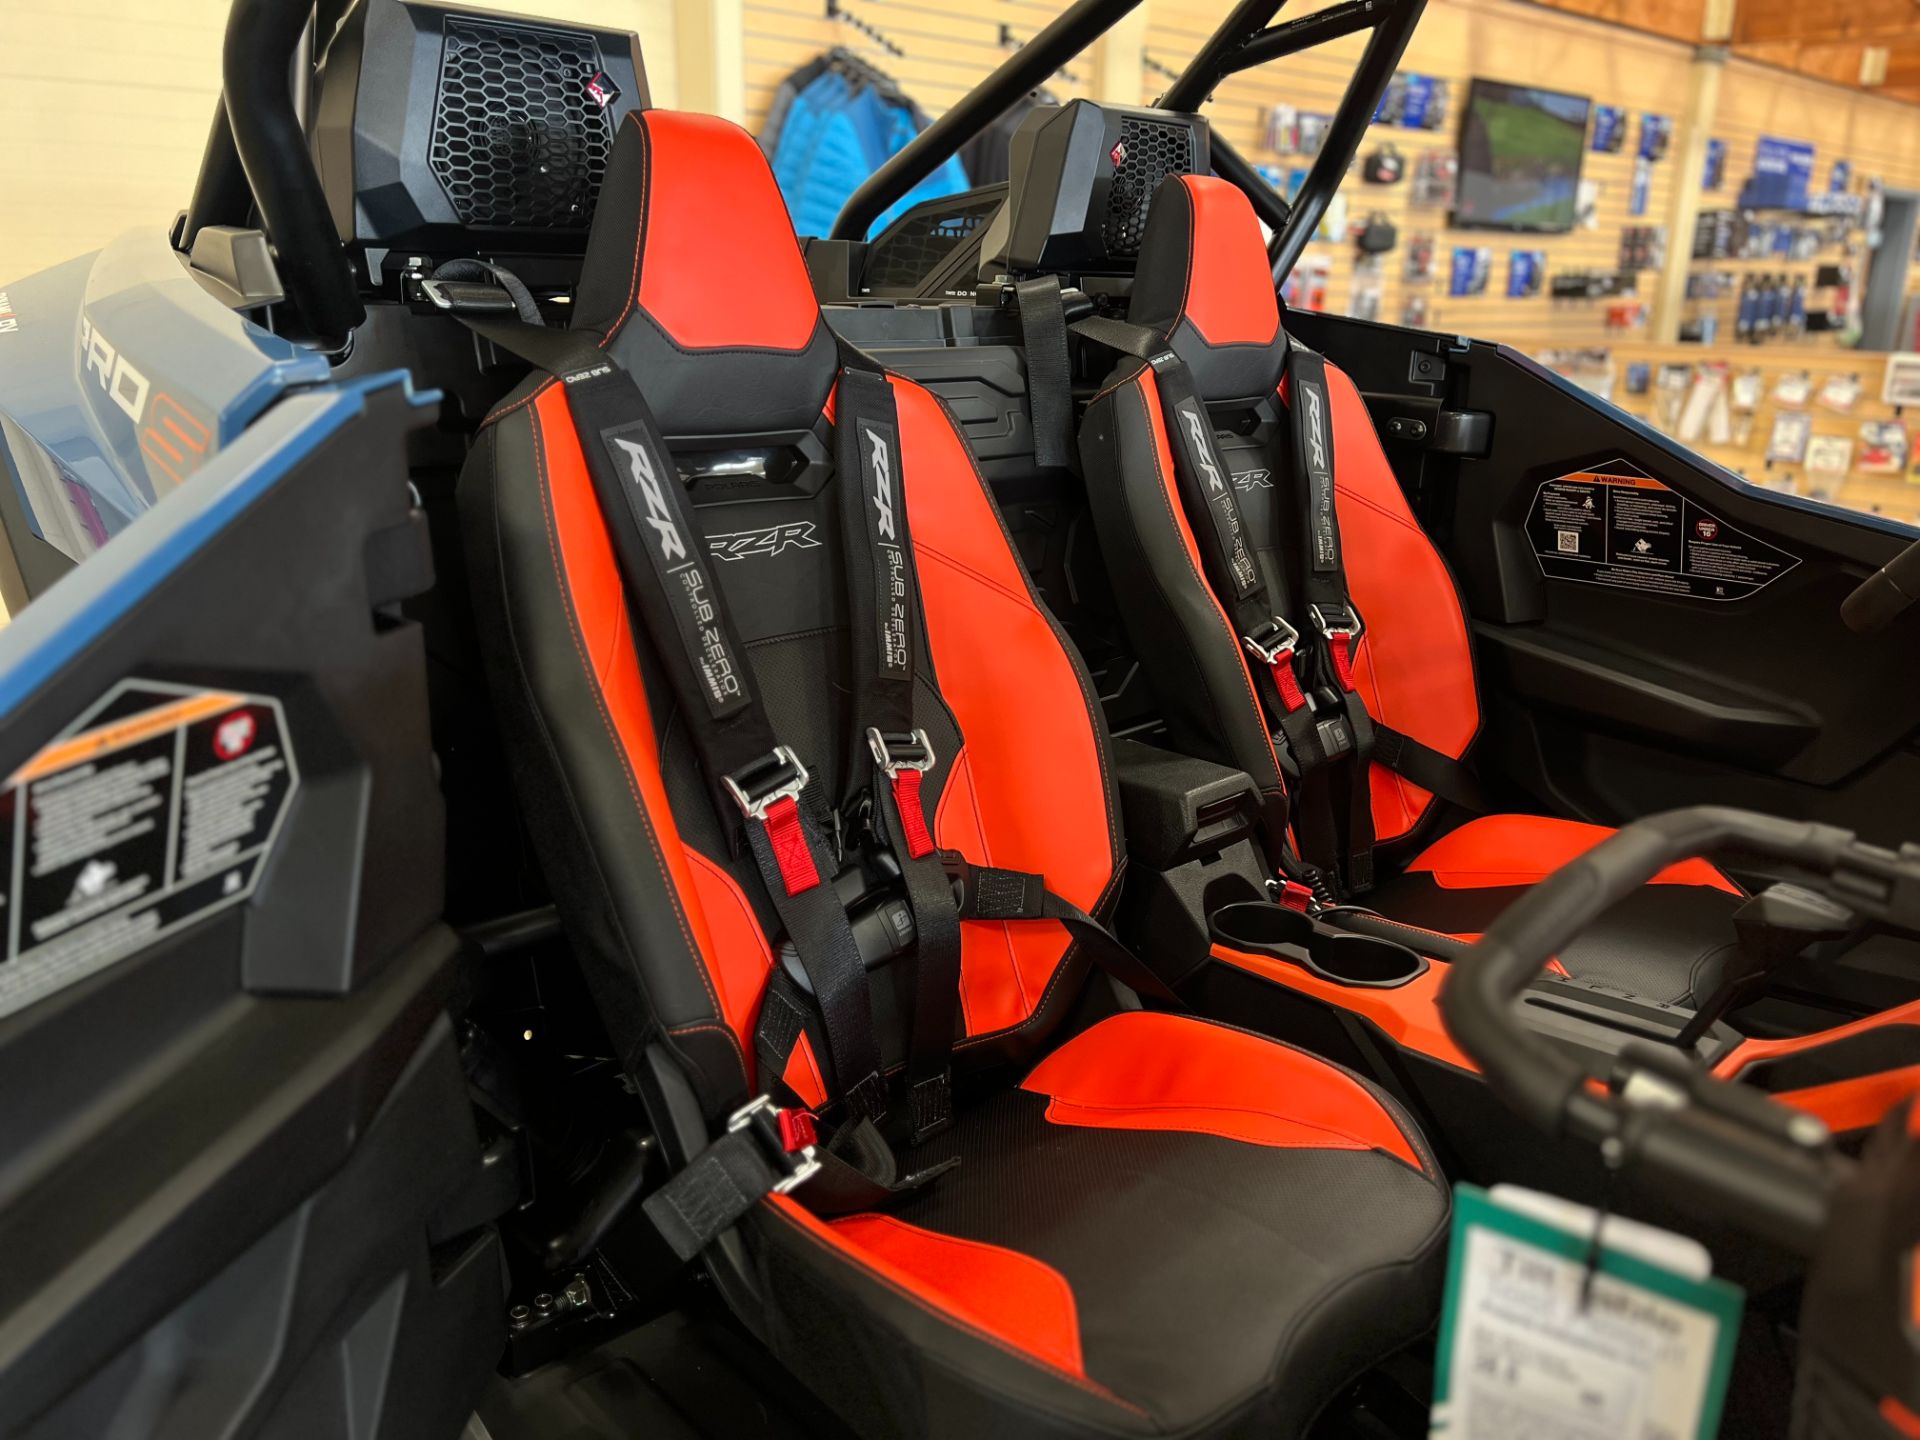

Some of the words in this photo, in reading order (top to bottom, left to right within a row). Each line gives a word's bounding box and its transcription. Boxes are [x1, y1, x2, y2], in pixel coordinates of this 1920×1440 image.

[566, 371, 591, 383] ZERO
[1182, 410, 1223, 492] RZR
[1305, 387, 1325, 469] RZR
[614, 438, 687, 561] RZR
[866, 428, 895, 541] RZR
[1230, 468, 1275, 493] ZR
[1601, 476, 1636, 486] WARNING
[891, 551, 905, 597] SUB
[1223, 498, 1239, 533] SUB
[1235, 536, 1255, 582] ZERO
[680, 573, 705, 632] CONTROLLED
[685, 569, 714, 622] SUB
[705, 627, 739, 694] ZERO
[894, 603, 907, 666] ZERO
